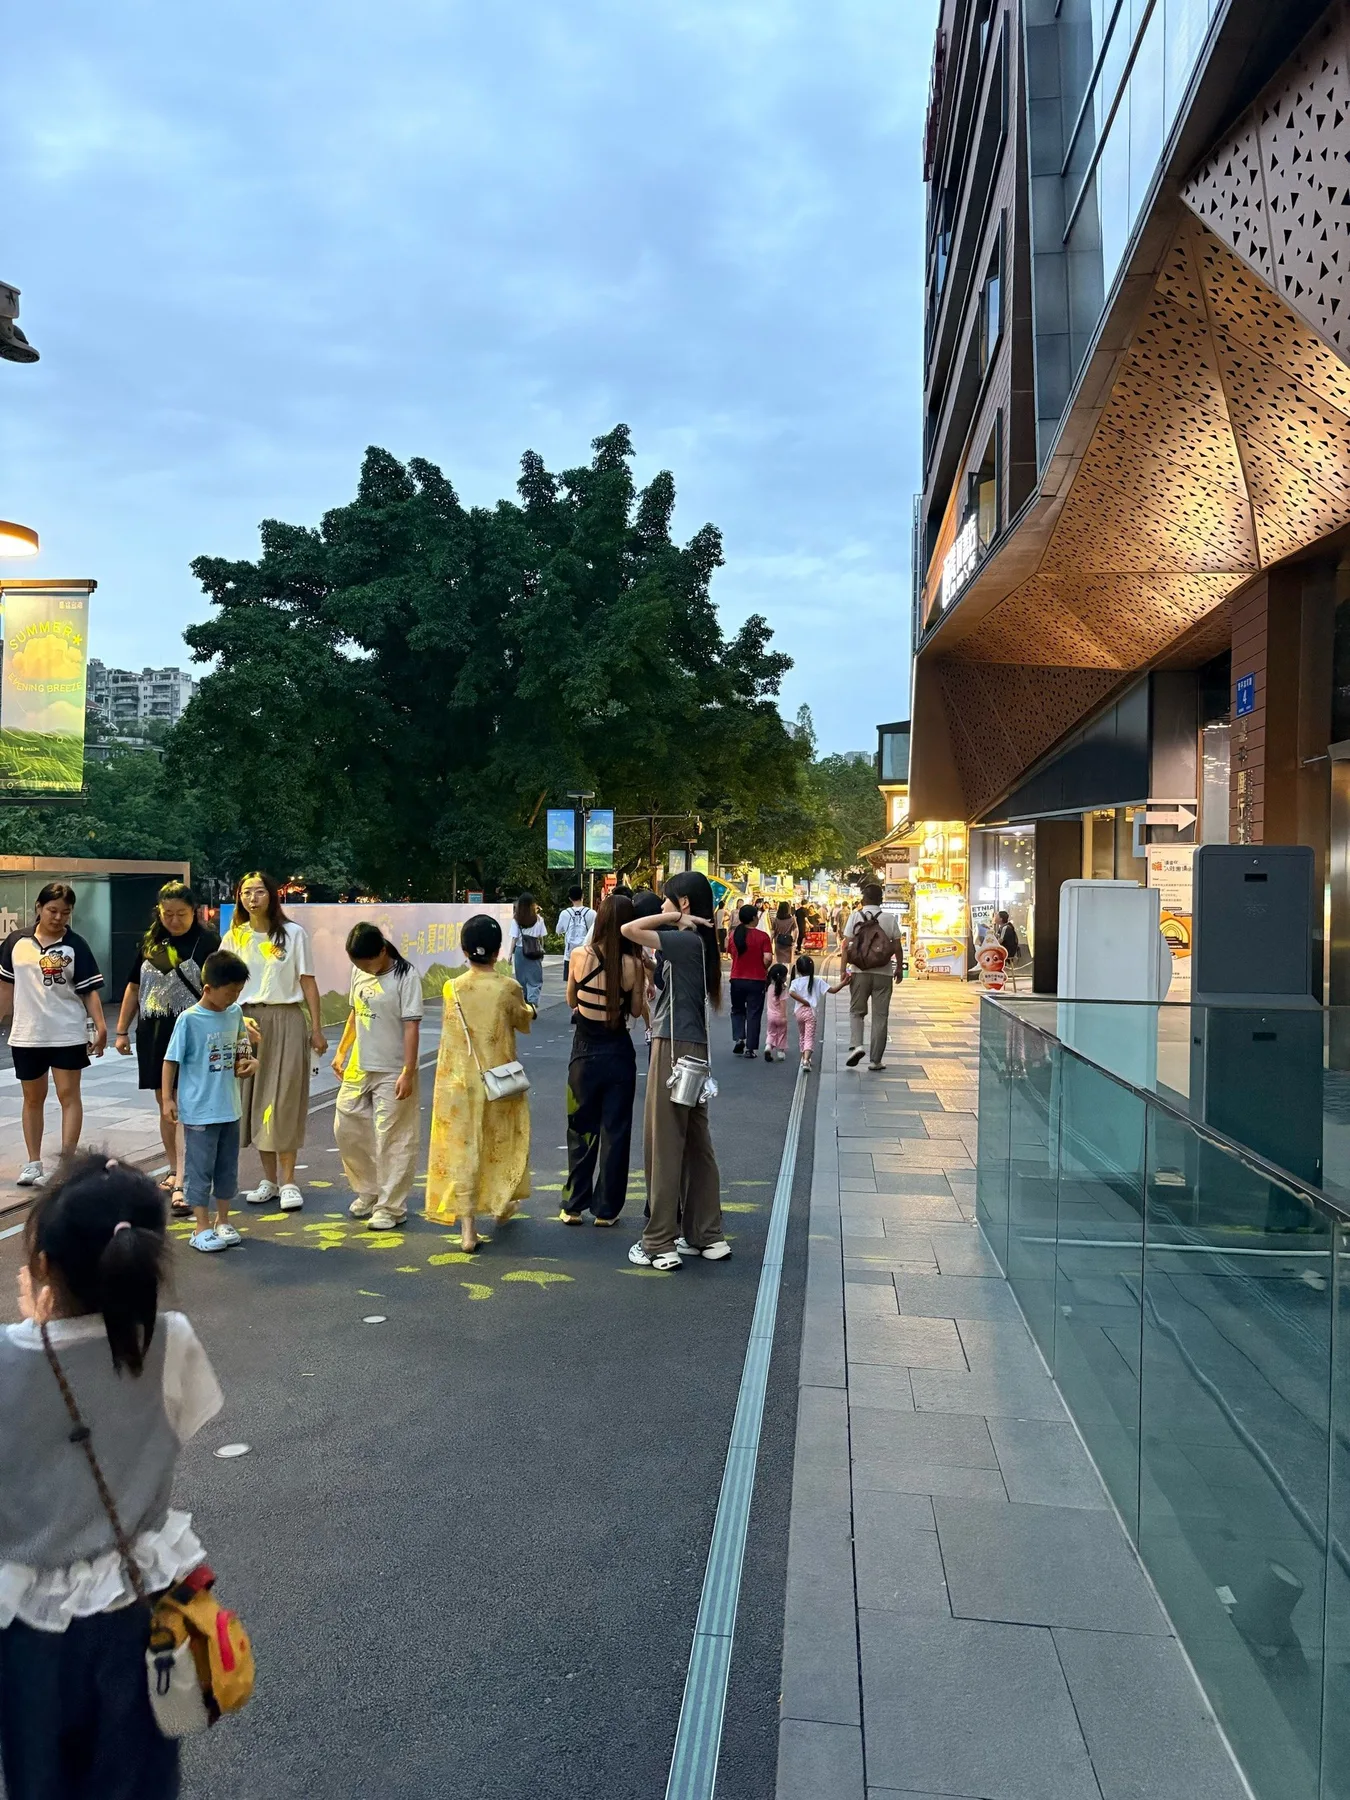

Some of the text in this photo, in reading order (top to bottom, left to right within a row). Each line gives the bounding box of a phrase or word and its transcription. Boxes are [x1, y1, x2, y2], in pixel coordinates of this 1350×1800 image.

[9, 620, 73, 651] SUMMER
[8, 672, 82, 692] EVENING BREEZE
